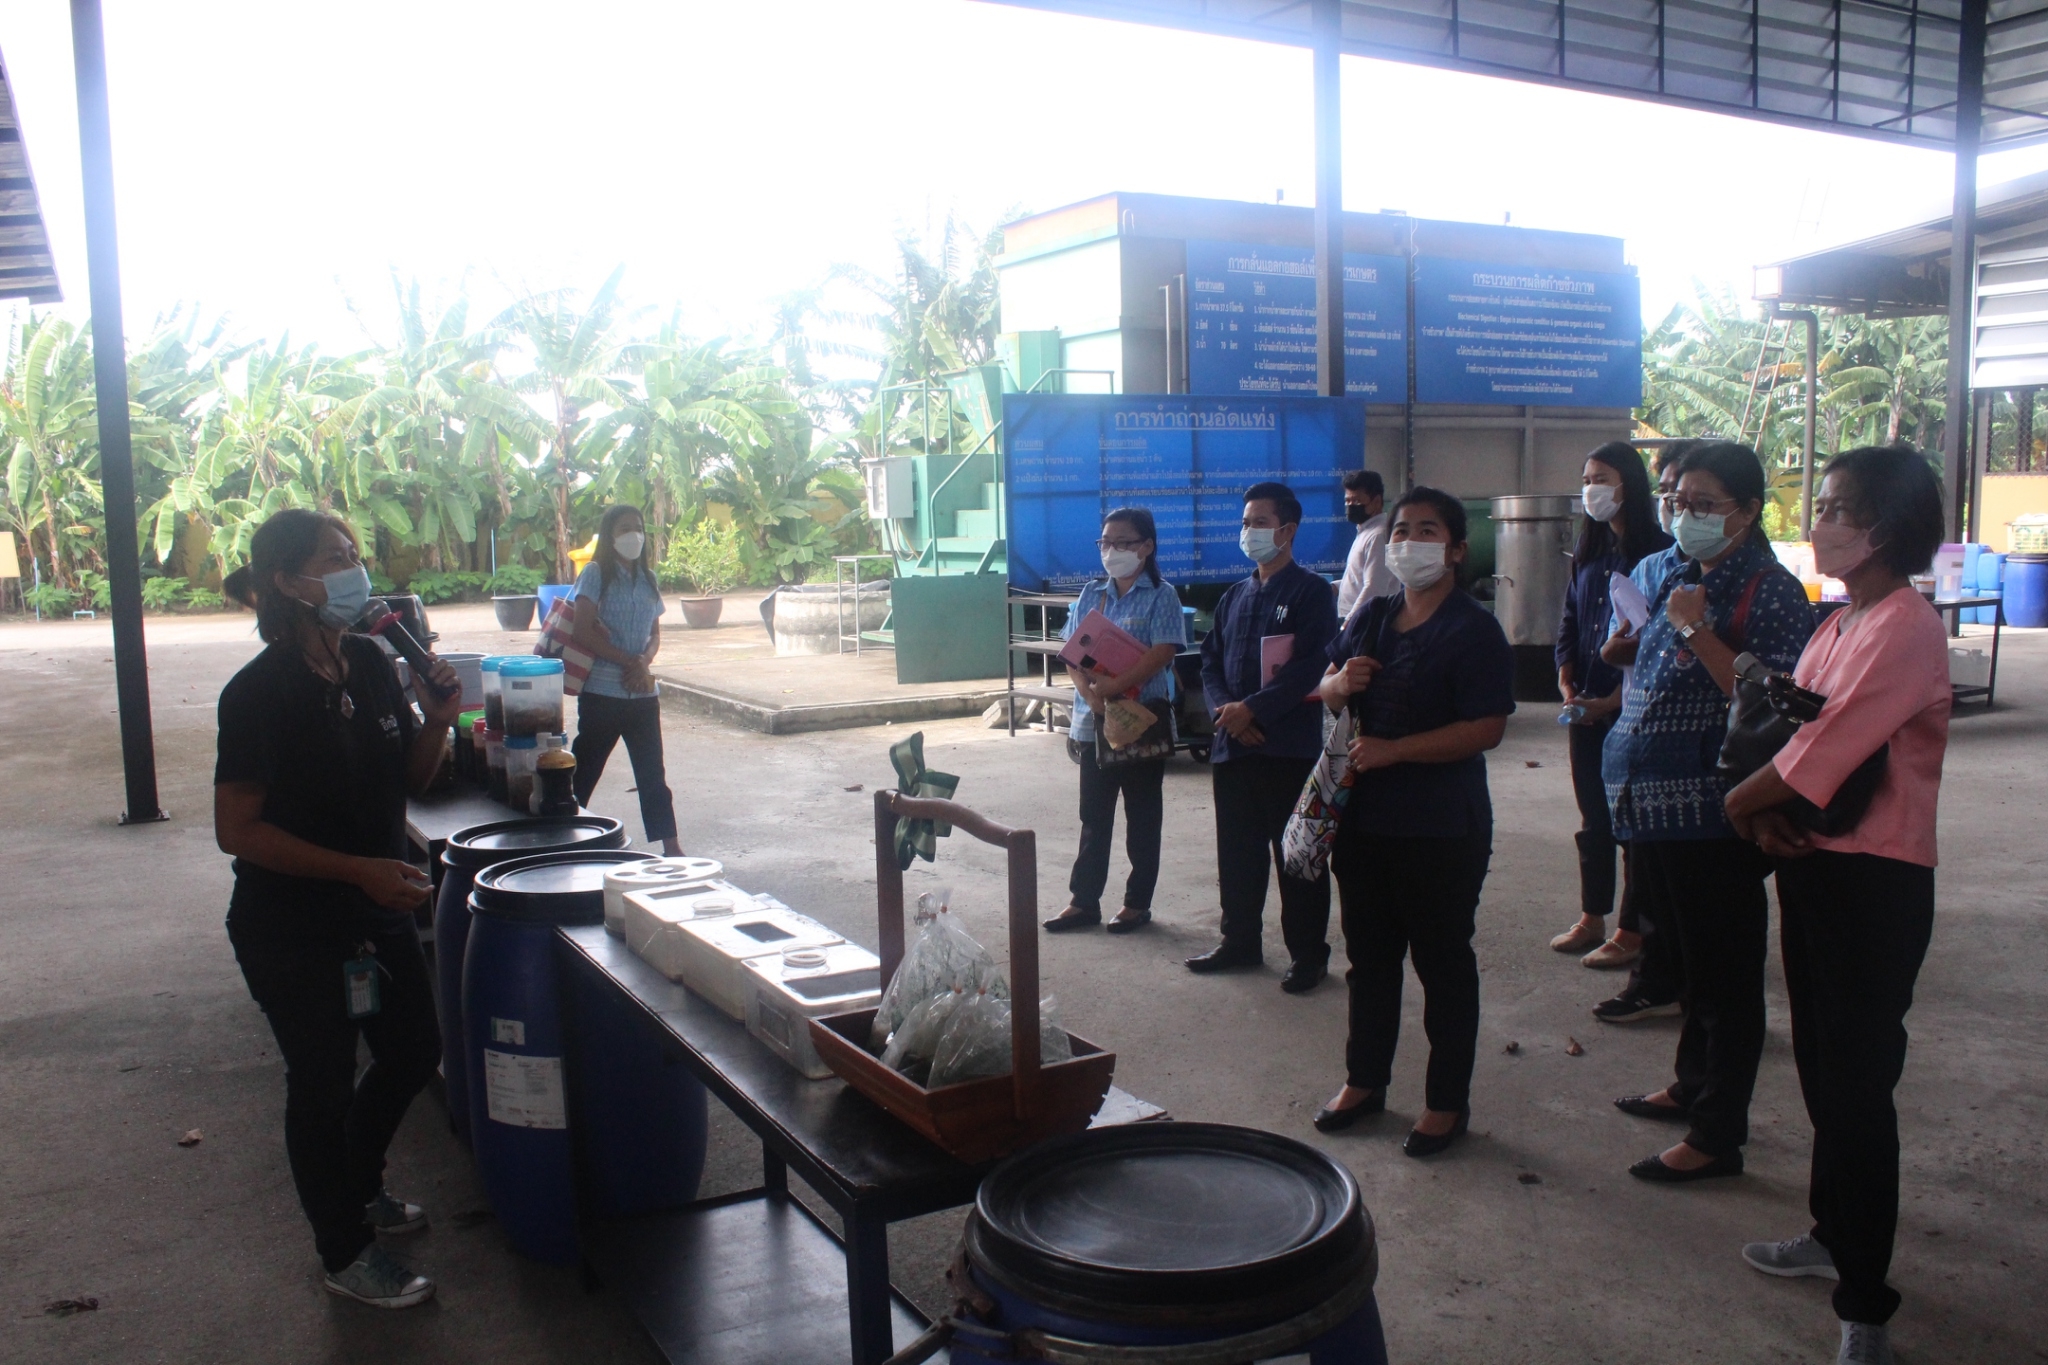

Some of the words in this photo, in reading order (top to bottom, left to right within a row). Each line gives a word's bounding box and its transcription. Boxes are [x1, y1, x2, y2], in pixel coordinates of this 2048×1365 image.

[1472, 272, 1595, 294] กระบวนการผลิตก๊าซชีวภาพ
[1114, 403, 1276, 430] การทำถ่านอัดแท่ง
